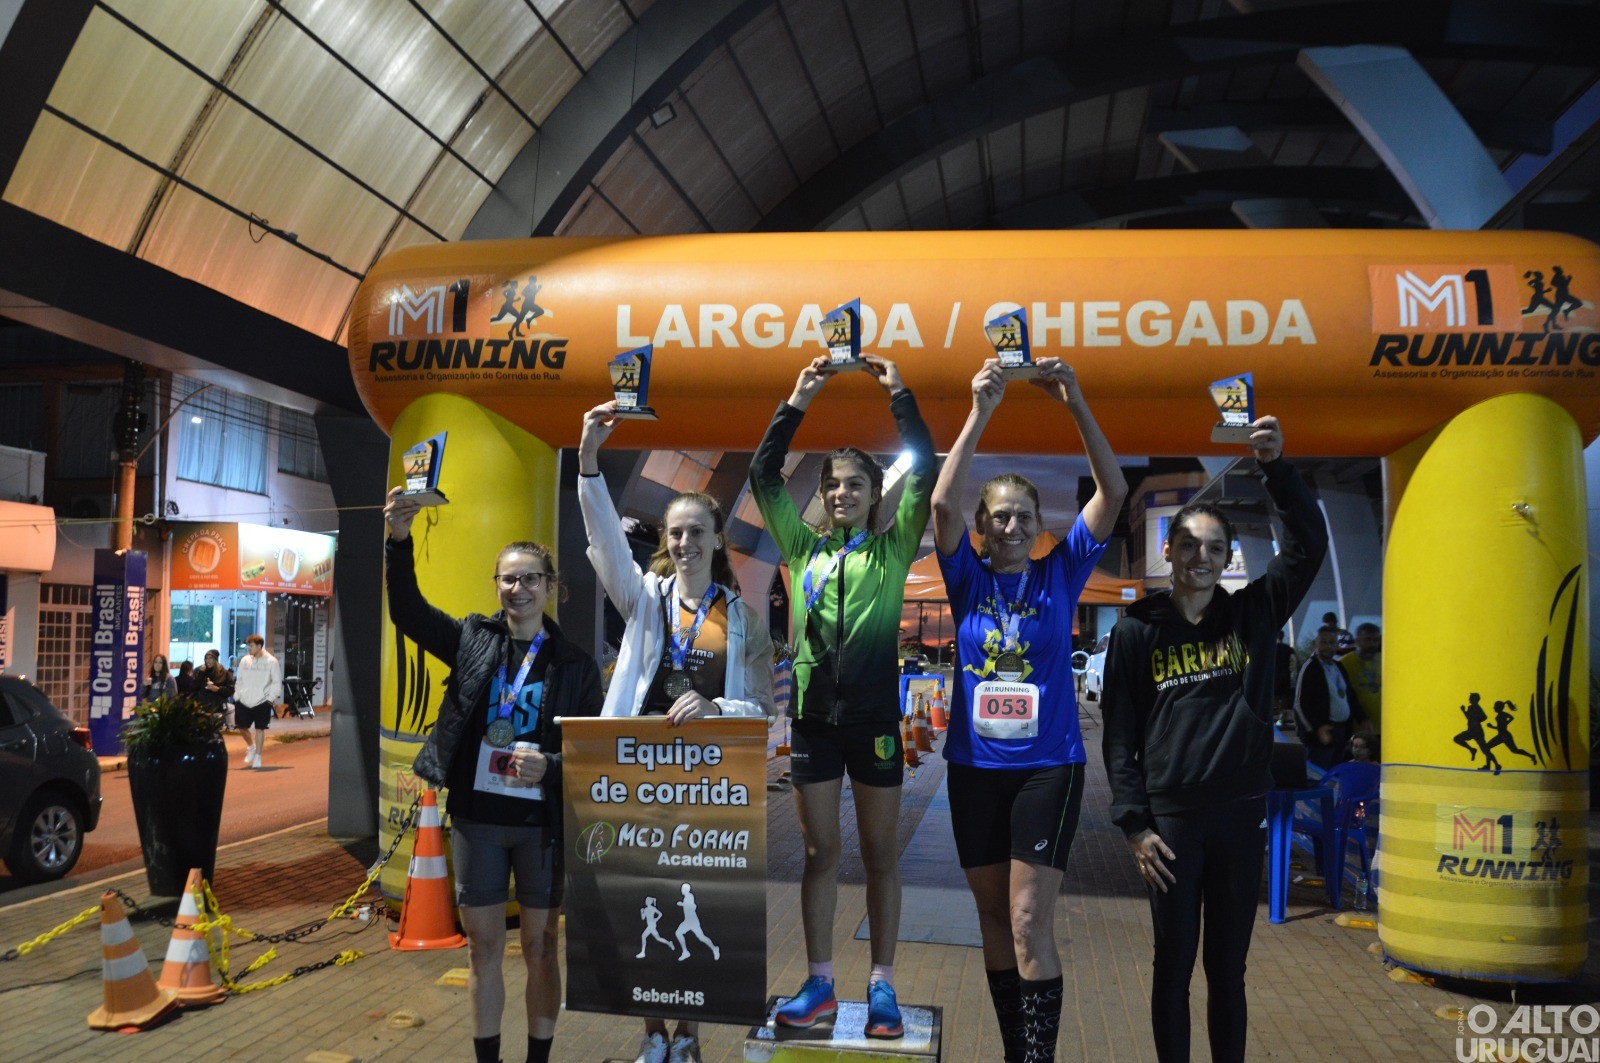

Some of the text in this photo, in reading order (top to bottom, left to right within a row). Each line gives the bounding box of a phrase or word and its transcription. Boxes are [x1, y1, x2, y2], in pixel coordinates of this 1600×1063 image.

[388, 278, 471, 336] M1
[1396, 269, 1494, 328] M1
[616, 302, 924, 349] LARGADA
[943, 302, 962, 349] /
[369, 338, 569, 373] RUNNING
[1369, 332, 1600, 367] RUNNING
[374, 373, 418, 382] Assessoria
[426, 371, 481, 382] Organização
[482, 371, 494, 380] de
[495, 371, 529, 381] Corrida
[530, 371, 542, 380] de
[543, 372, 561, 381] Rua
[1374, 368, 1596, 380] Assessoria e Organização de Corrida de Rua
[182, 531, 199, 554] CREPE
[210, 530, 228, 553] PRAÇA
[115, 585, 123, 631] IMPLANTES
[92, 584, 116, 693] Oral Brasil
[123, 585, 141, 694] Oral Brasil
[984, 686, 1030, 694] M1RUNNING
[1156, 678, 1179, 692] CENTRO
[1180, 676, 1189, 686] DE
[987, 698, 1028, 716] 053
[616, 737, 723, 772] Equipe
[590, 775, 750, 807] de corrida
[671, 823, 750, 851] FORMA
[1453, 812, 1514, 855] M1
[657, 851, 748, 868] Academia
[1436, 854, 1574, 881] RUNNING
[632, 987, 705, 1006] Seberi-RS
